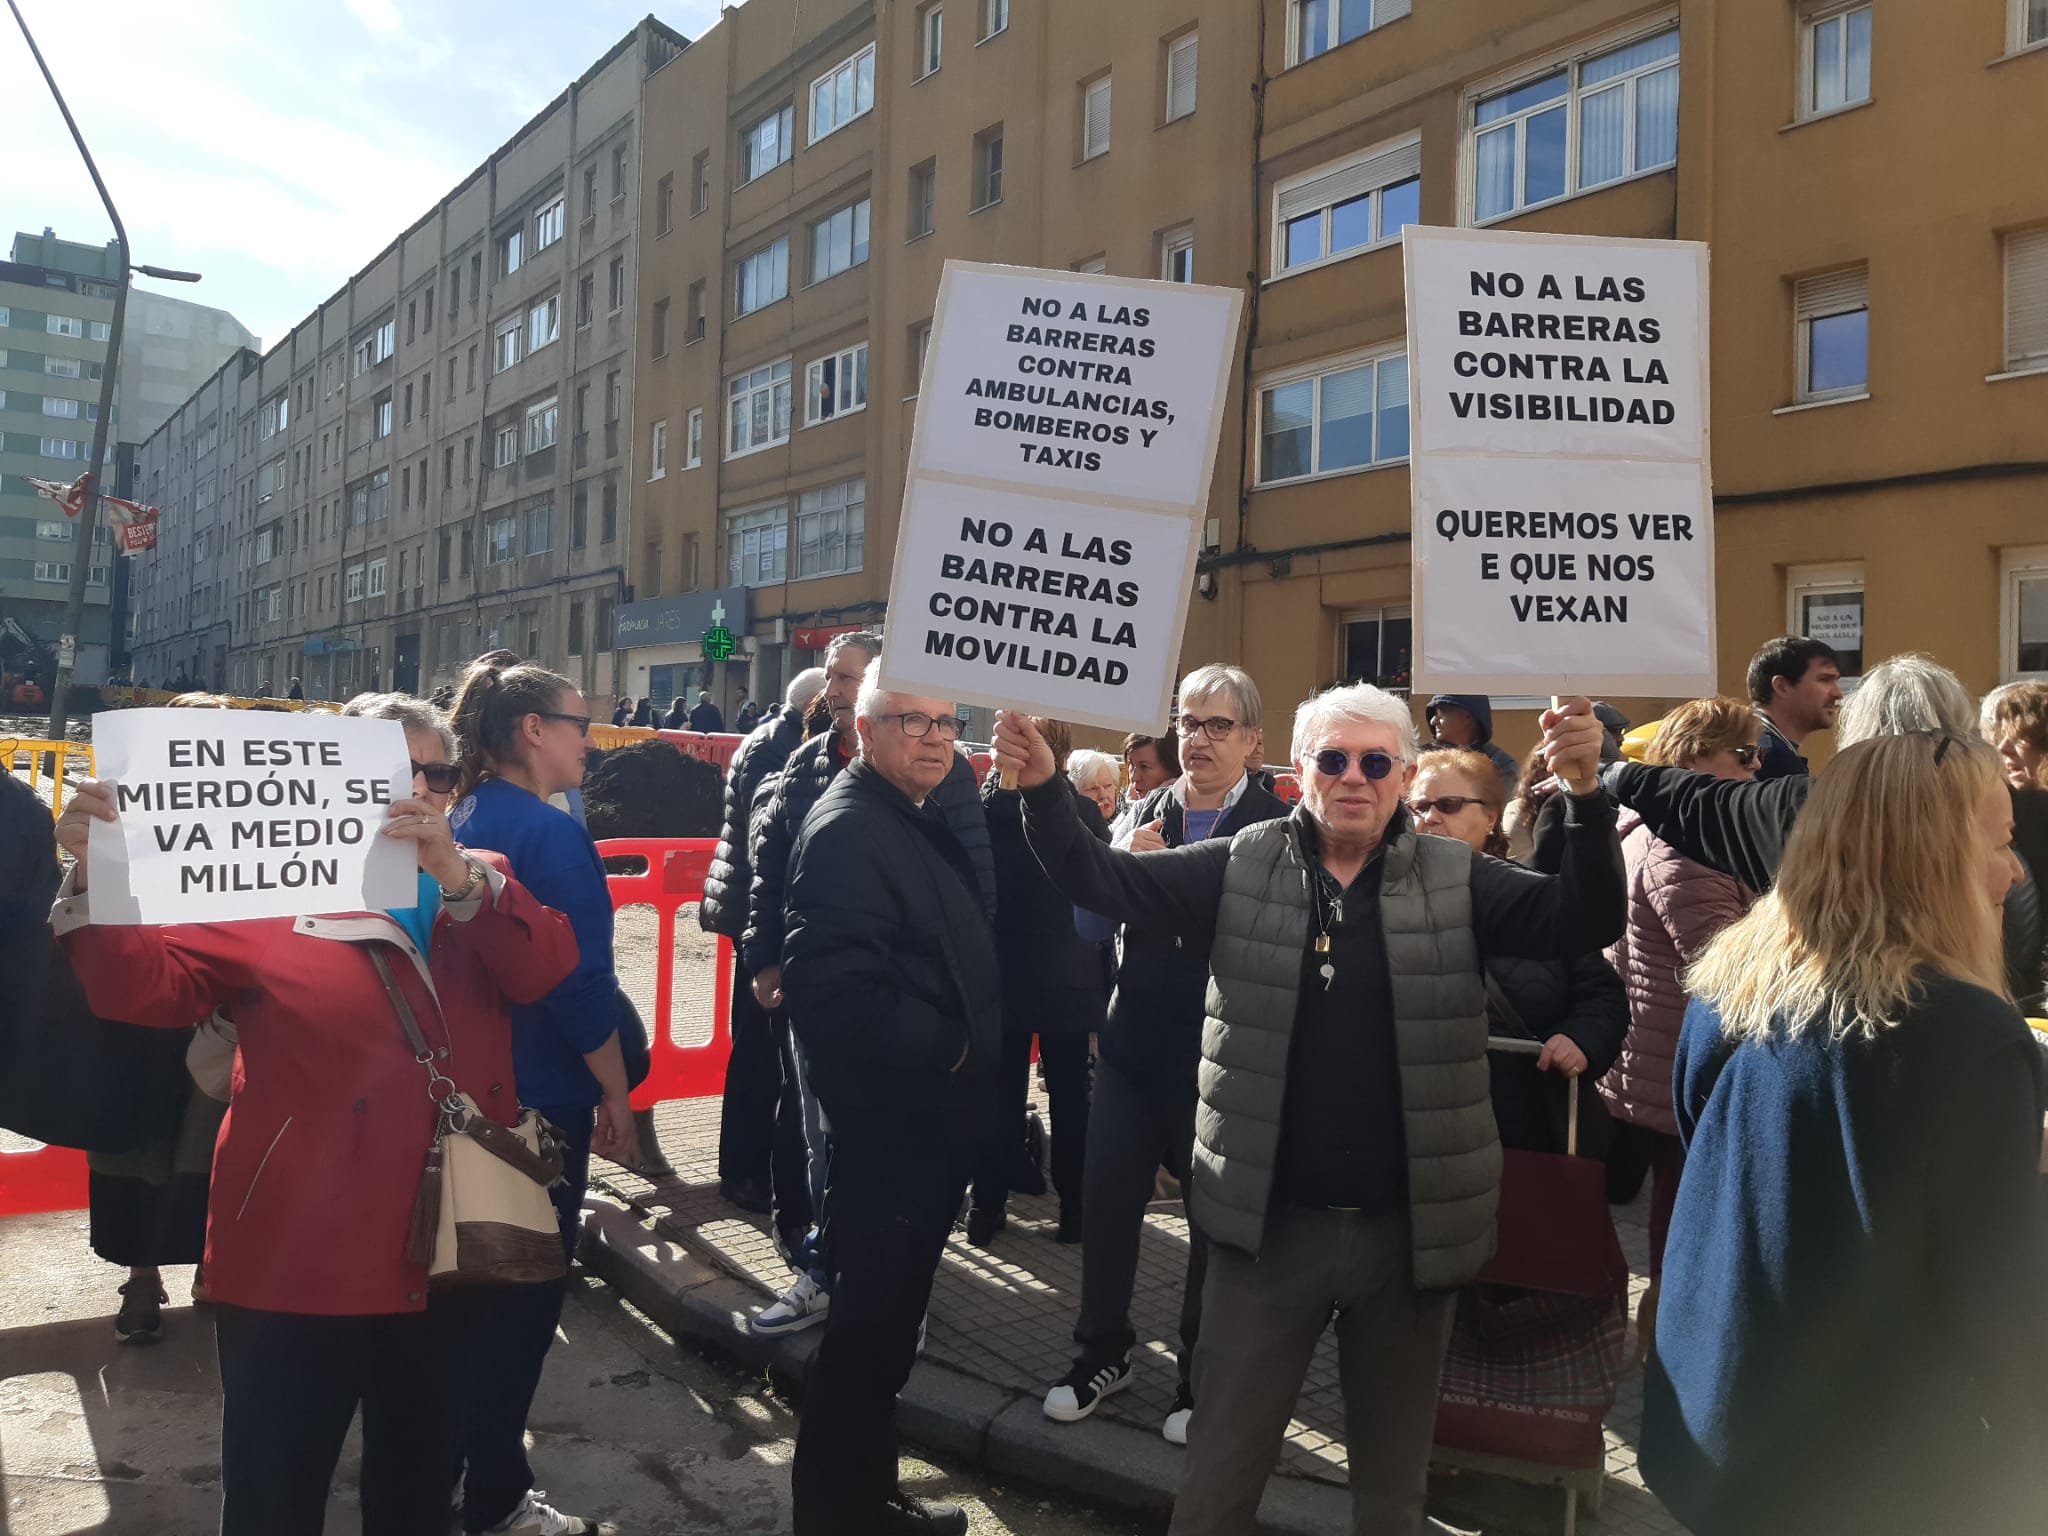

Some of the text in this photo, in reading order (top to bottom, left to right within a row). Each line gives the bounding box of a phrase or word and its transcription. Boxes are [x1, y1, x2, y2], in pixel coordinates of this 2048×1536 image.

[1471, 270, 1645, 302] NO A LAS
[1021, 296, 1150, 327] NO A LAS
[1458, 310, 1661, 344] BARRERAS
[1006, 324, 1156, 358] BARRERAS
[1018, 355, 1132, 386] CONTRA
[1453, 351, 1669, 385] CONTRA LA
[964, 377, 1175, 426] AMBULANCIAS,
[1448, 391, 1675, 425] VISIBILIDAD
[974, 407, 1159, 448] BOMBEROS Y
[1019, 443, 1102, 472] TAXIS
[960, 516, 1133, 566] NO A LAS
[1436, 509, 1694, 543] QUEREMOS VER
[940, 553, 1140, 608] BARRERAS
[1480, 552, 1655, 585] E QUE NOS
[929, 592, 1137, 649] CONTRA LA
[1509, 594, 1628, 623] VEXAN
[924, 629, 1129, 686] MOVILIDAD
[169, 740, 342, 767] EN ESTE
[117, 770, 391, 812] MIERDÓN, SE
[154, 818, 363, 852] VA MEDIO
[181, 852, 338, 894] MILLÓN
